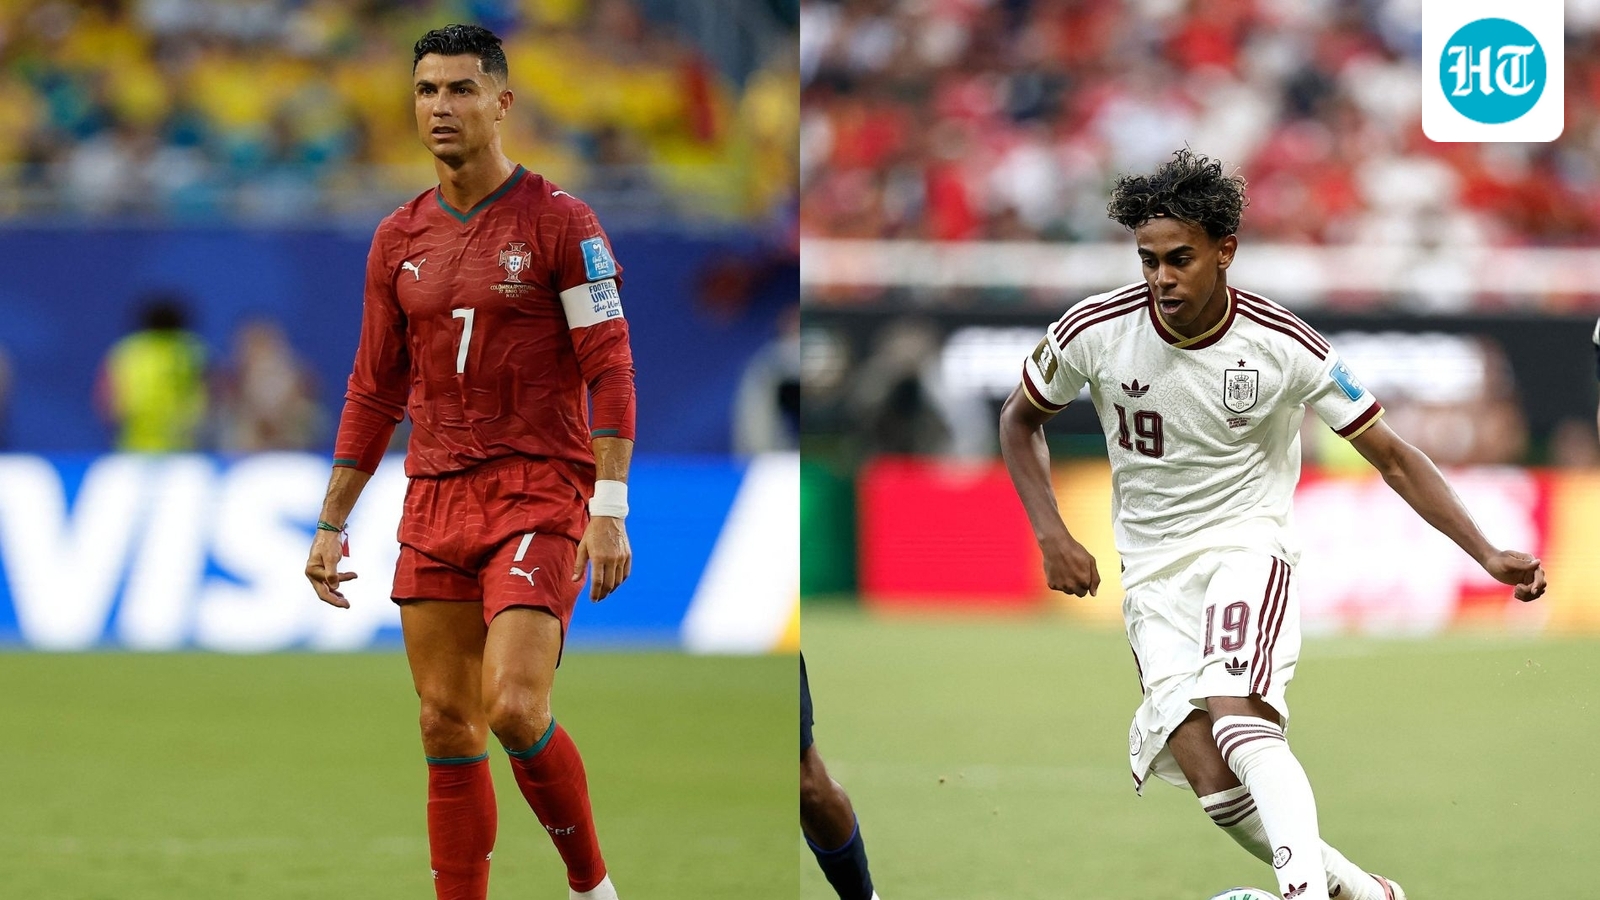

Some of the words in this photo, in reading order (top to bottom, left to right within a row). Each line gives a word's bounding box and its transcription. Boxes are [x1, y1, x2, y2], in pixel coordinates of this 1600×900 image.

[591, 289, 619, 303] UNITE
[452, 308, 475, 373] 7
[1113, 403, 1164, 458] 19
[1203, 600, 1251, 659] 19
